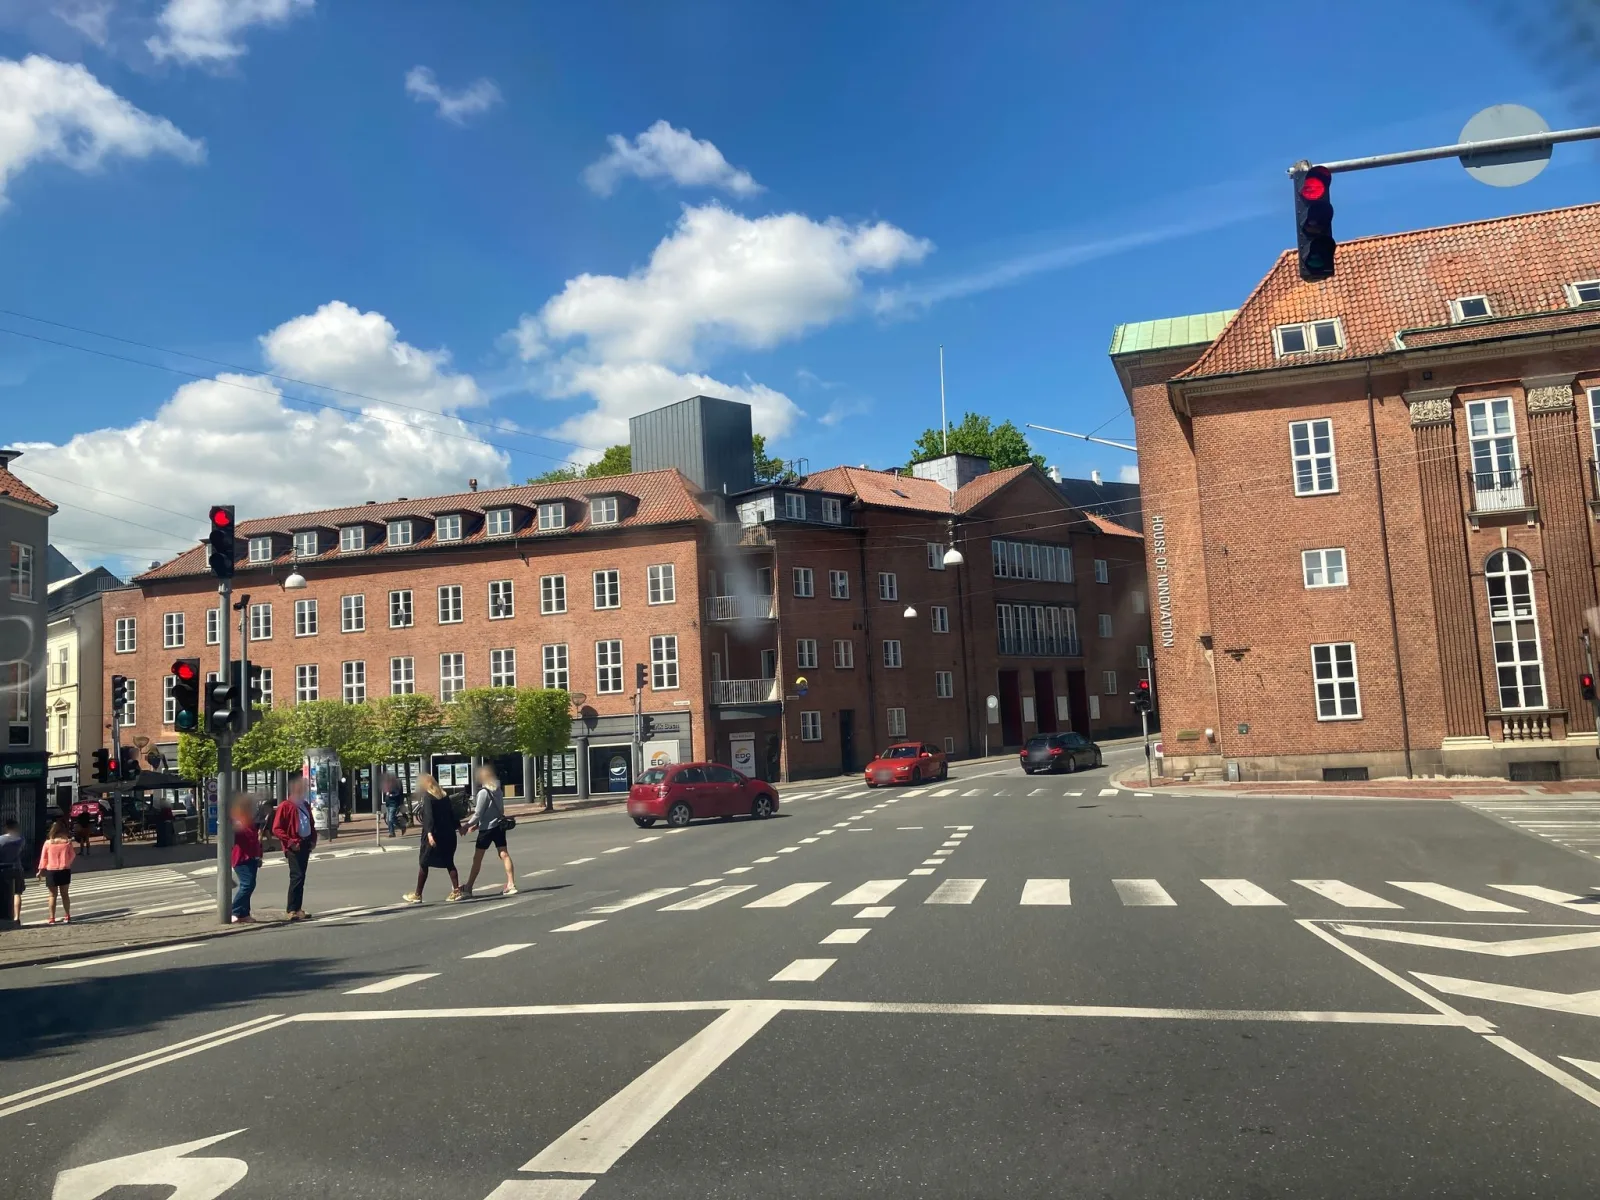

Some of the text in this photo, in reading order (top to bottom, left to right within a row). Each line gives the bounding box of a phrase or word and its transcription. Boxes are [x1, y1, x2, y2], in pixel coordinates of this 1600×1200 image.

[1152, 515, 1174, 648] HOUSE OF INNOVATION
